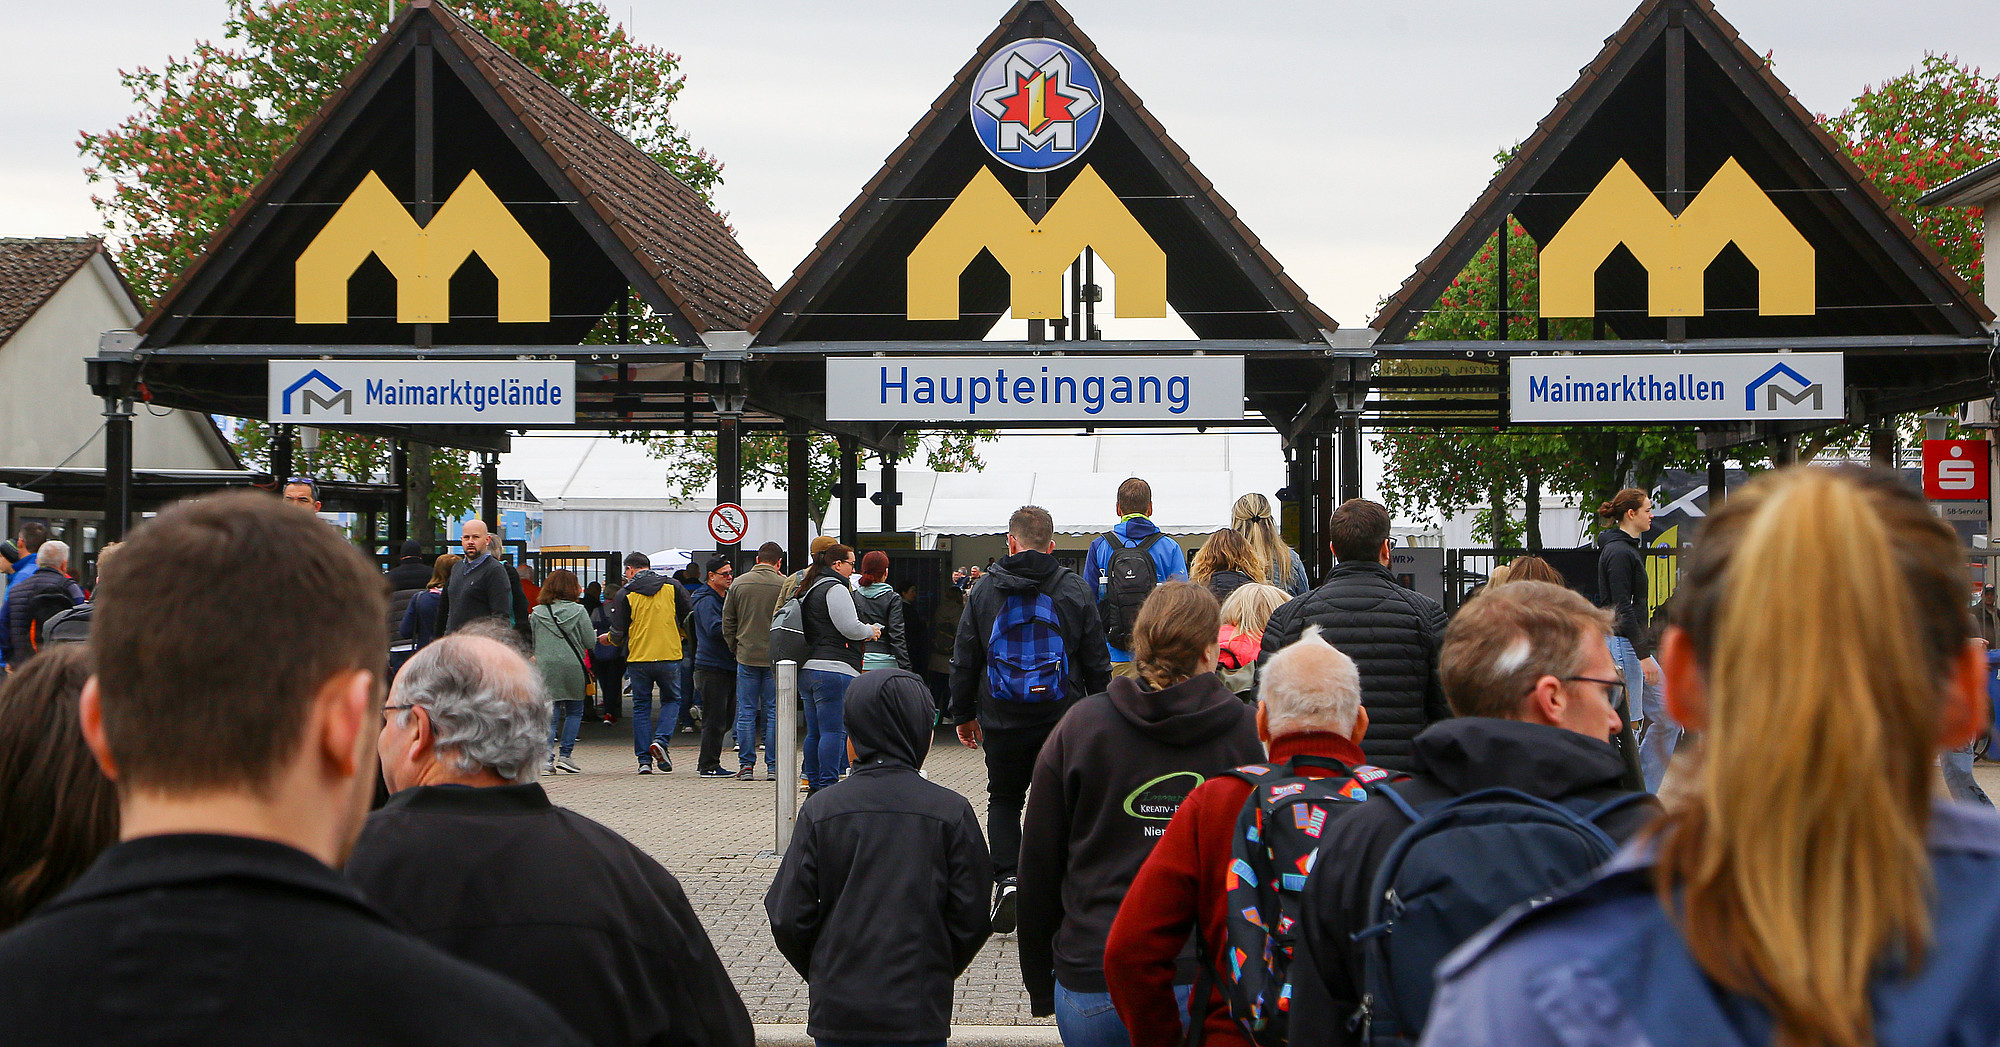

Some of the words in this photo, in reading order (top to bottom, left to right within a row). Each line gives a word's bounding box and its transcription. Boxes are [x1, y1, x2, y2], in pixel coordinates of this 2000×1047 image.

[366, 377, 562, 412] Maimarktgelände
[880, 366, 1190, 415] Haupteingang
[1529, 373, 1724, 403] Maimarkthallen
[1946, 507, 1984, 516] SB-Service
